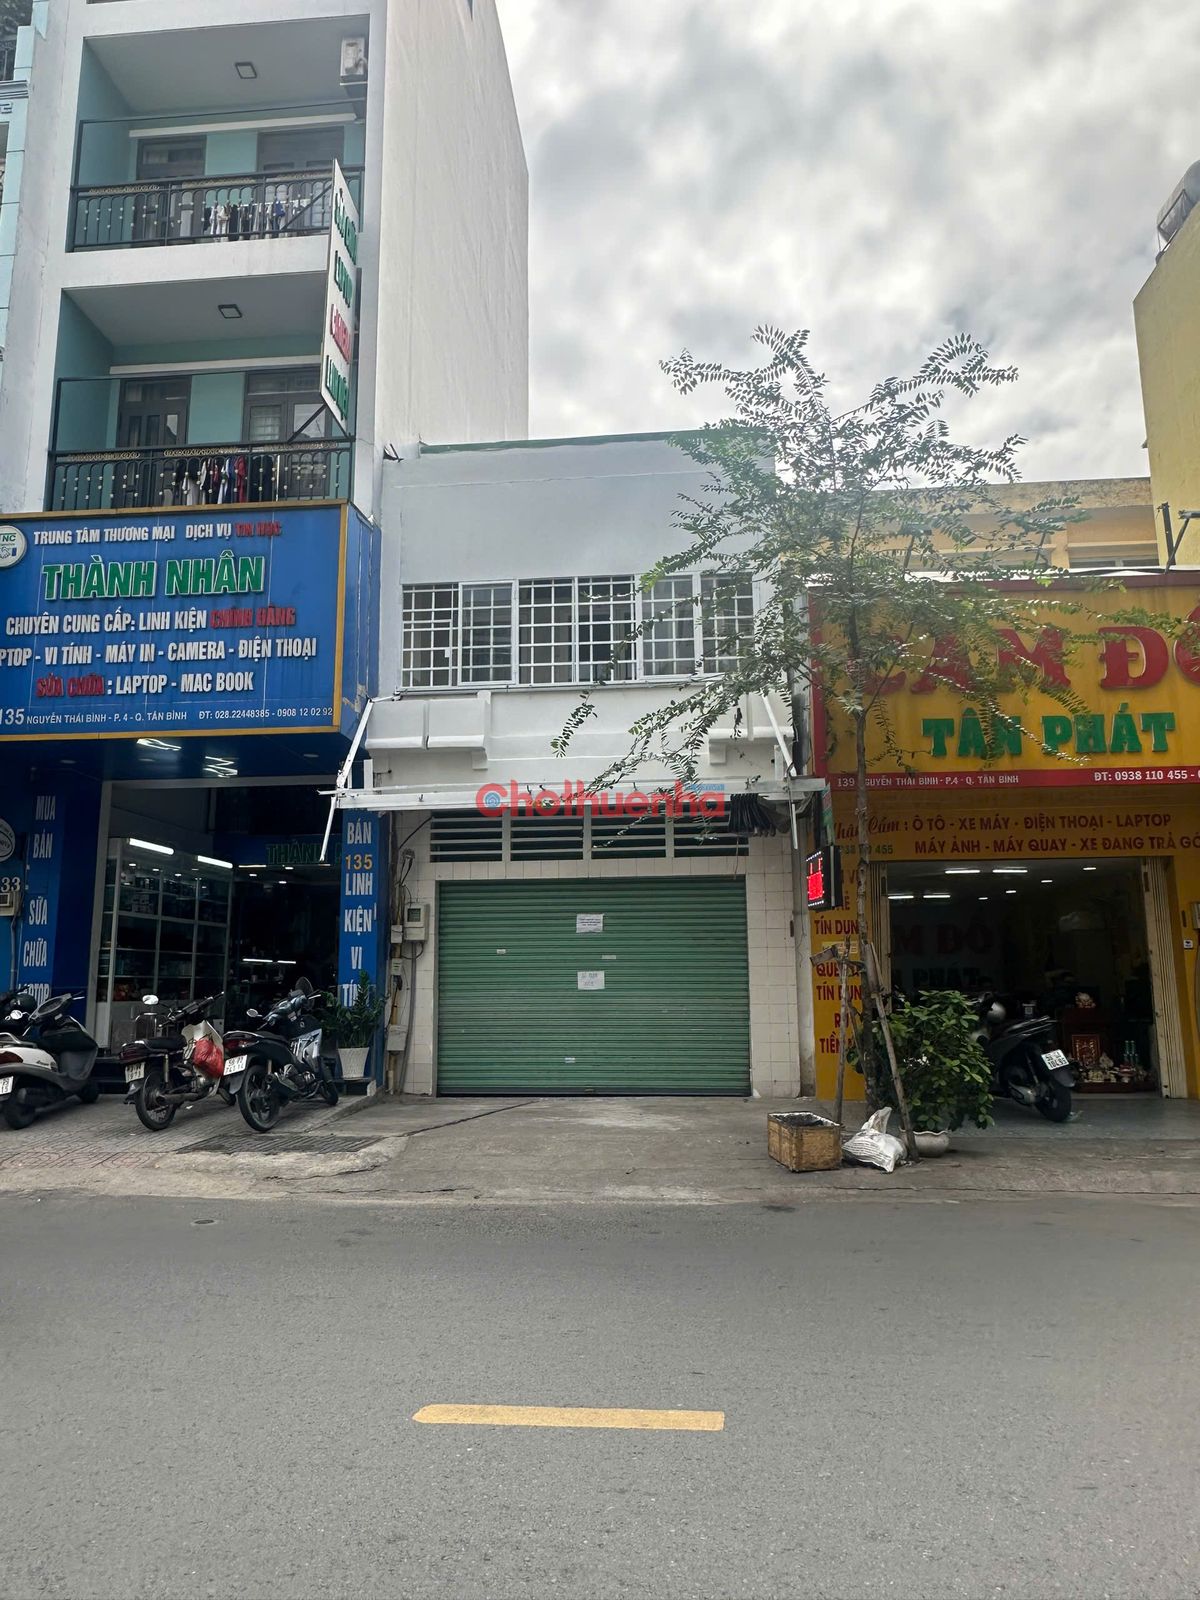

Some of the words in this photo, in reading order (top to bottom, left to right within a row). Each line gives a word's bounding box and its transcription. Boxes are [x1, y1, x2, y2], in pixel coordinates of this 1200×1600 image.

[34, 530, 73, 545] TRUNG
[75, 527, 101, 543] TÂM
[103, 526, 149, 542] THƯƠNG
[152, 525, 176, 541] MẠI
[216, 522, 232, 540] VỤ
[42, 554, 158, 600] THÀNH
[165, 549, 265, 596] NHÂN
[6, 611, 60, 636] CHUYÊN
[62, 614, 100, 634] CUNG
[138, 610, 171, 631] LINH
[174, 606, 207, 633] KIỆN
[44, 646, 59, 665] VI
[61, 641, 93, 665] TÍNH
[105, 640, 136, 664] MÁY
[139, 643, 155, 662] IN
[168, 640, 226, 662] CAMERA
[238, 635, 272, 663] ĐIỆN
[276, 637, 317, 661] THOẠI
[115, 674, 168, 695] LAPTOP
[180, 672, 213, 692] MAC
[215, 671, 254, 692] BOOK
[26, 711, 62, 725] NGUYỄN
[64, 712, 84, 724] THÁI
[86, 711, 107, 723] BÌNH
[166, 709, 187, 721] BÌNH
[277, 707, 297, 717] 0908
[299, 707, 309, 717] 12
[310, 707, 321, 717] 02
[323, 707, 333, 717] 92
[921, 706, 1023, 758] TÂN
[1041, 702, 1176, 756] PHÁT
[858, 775, 892, 787] GUYỄN
[1094, 771, 1112, 782] ĐT:
[1114, 771, 1142, 781] 0938
[1145, 770, 1164, 780] 110
[1167, 770, 1188, 780] 455
[36, 796, 56, 821] MUA
[346, 818, 372, 845] BÁN
[912, 815, 924, 832] Ô
[927, 813, 946, 832] TÔ
[958, 817, 976, 830] XE
[980, 813, 1010, 831] MÁY
[1024, 812, 1056, 833] ĐIỆN
[1059, 814, 1104, 832] THOẠI
[1115, 813, 1172, 828] LAPTOP
[33, 828, 53, 859] BÁN
[914, 836, 946, 855] MÁY
[993, 835, 1024, 853] MÁY
[1027, 838, 1068, 852] QUAY
[1080, 837, 1098, 851] XE
[1102, 836, 1145, 850] ĐANG
[345, 853, 374, 871] 135
[344, 872, 373, 896] LINH
[344, 904, 373, 937] KIỆN
[813, 915, 833, 935] TÍN
[350, 946, 363, 970] VI
[342, 979, 370, 1008] TÍN
[815, 981, 835, 1001] TÍN
